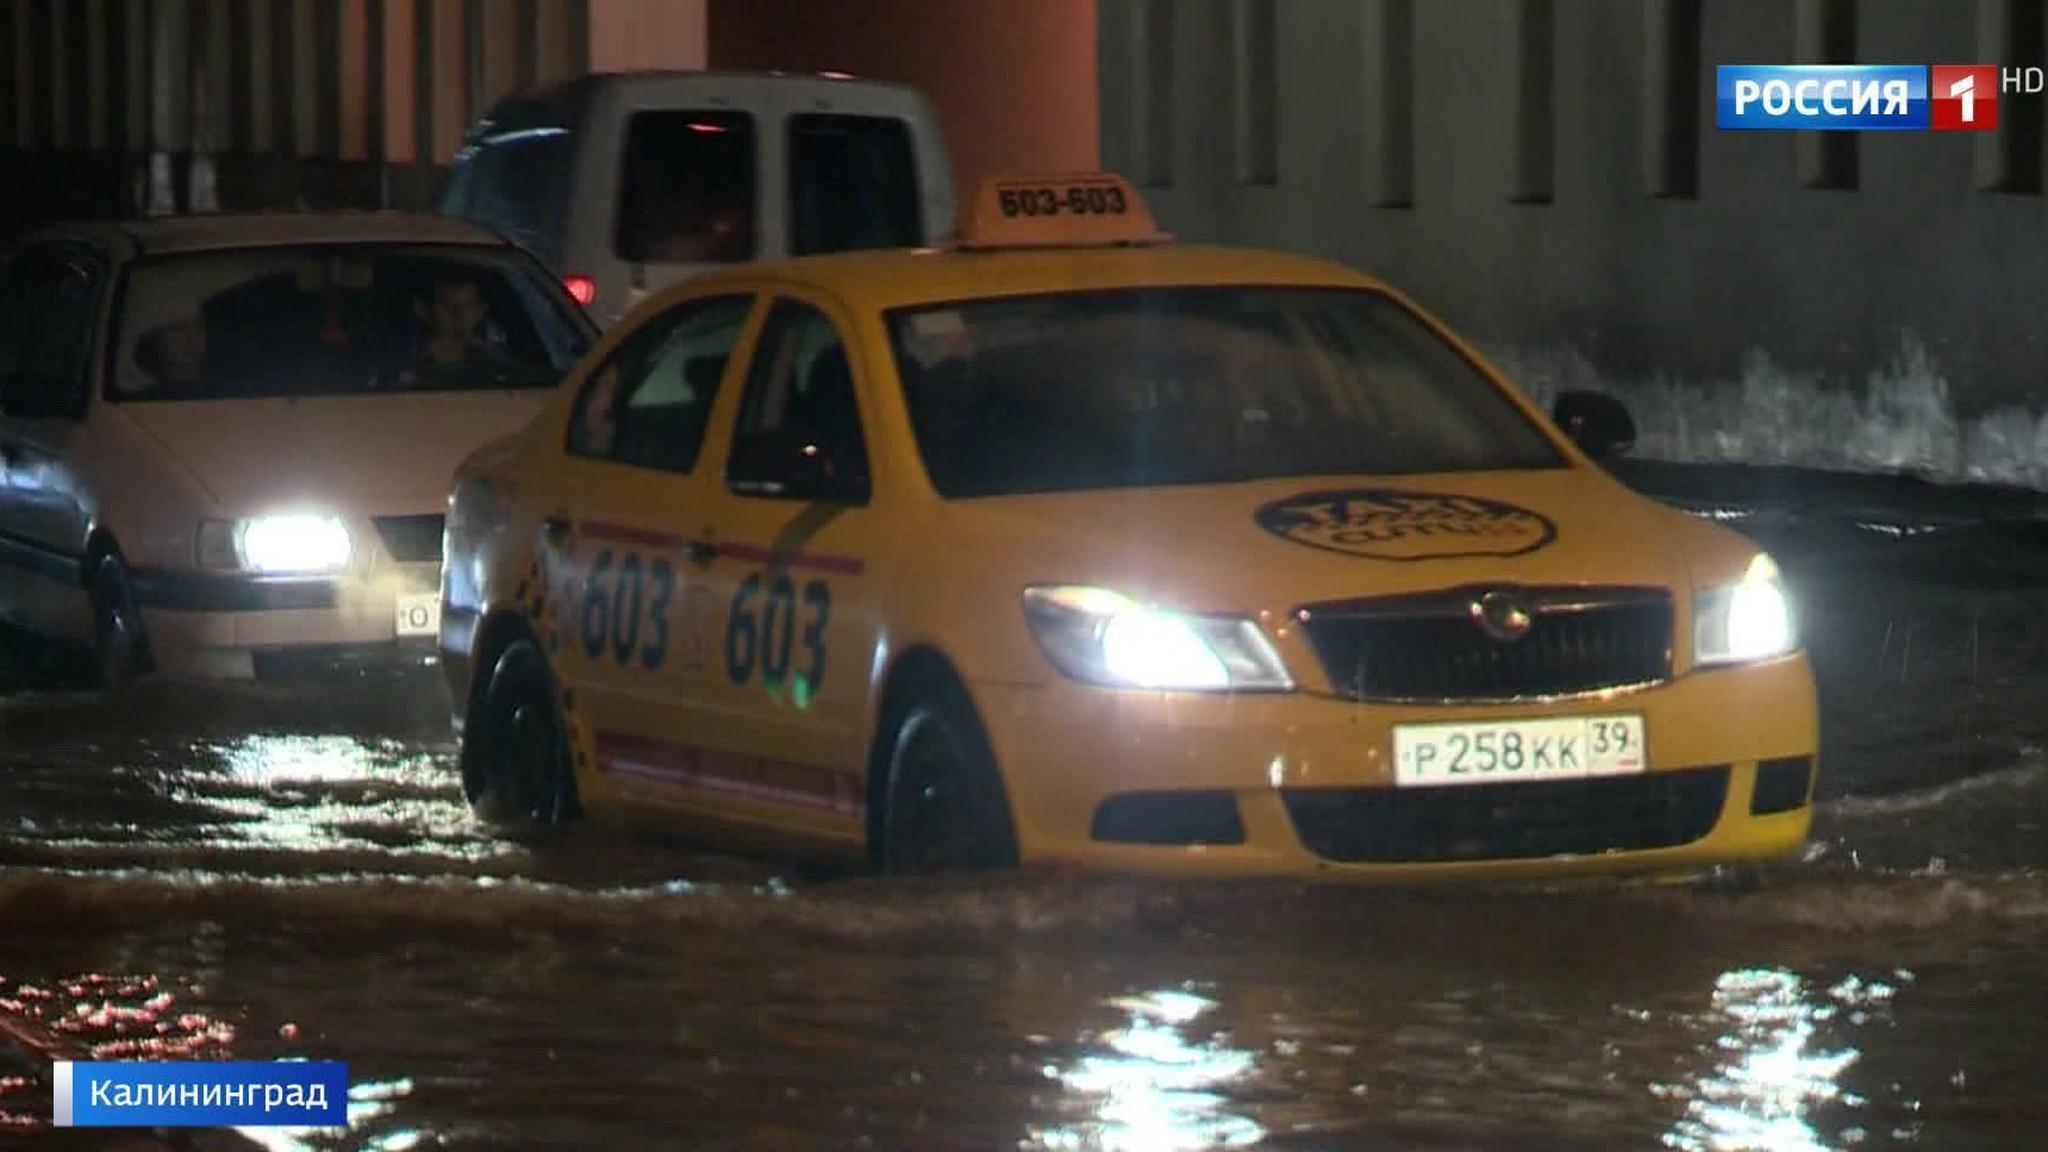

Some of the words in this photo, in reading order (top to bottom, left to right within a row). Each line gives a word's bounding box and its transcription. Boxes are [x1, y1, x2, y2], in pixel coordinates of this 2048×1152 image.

[1000, 187, 1127, 217] 603-603
[582, 550, 677, 669] 603
[725, 570, 832, 699] 603
